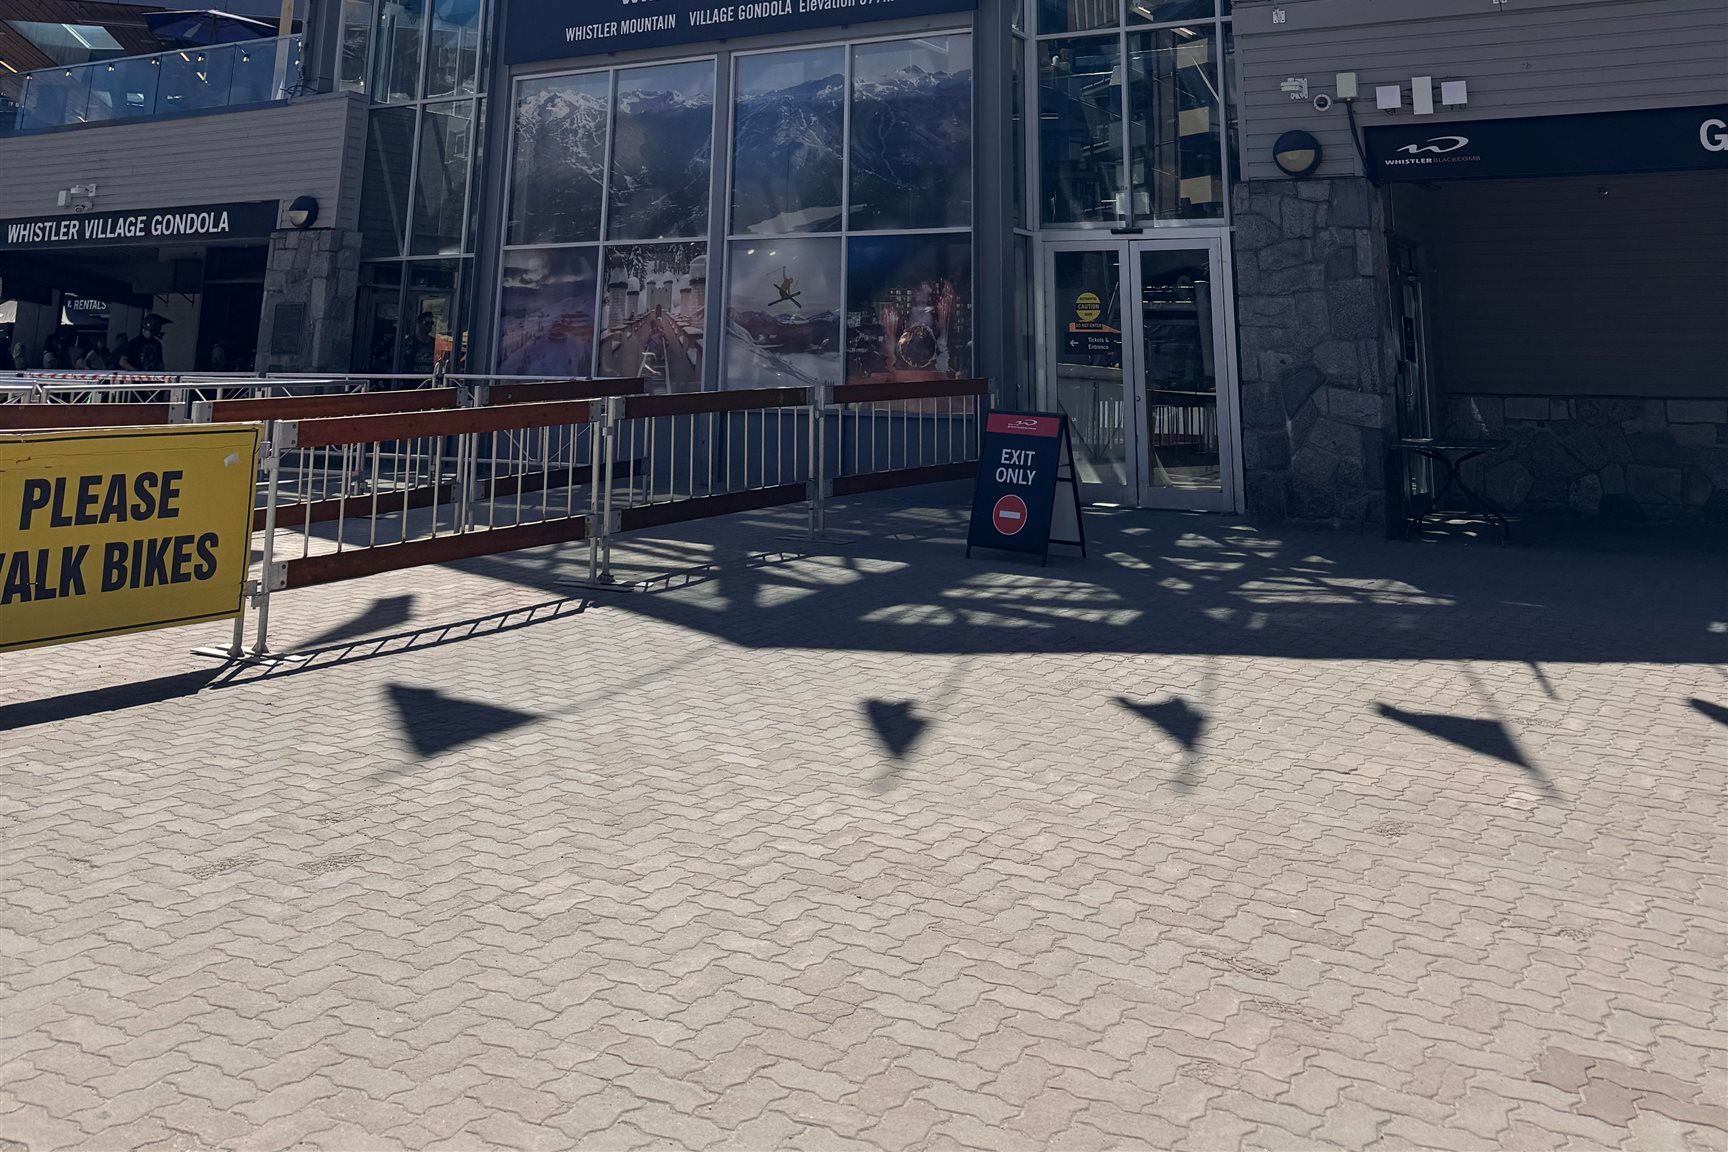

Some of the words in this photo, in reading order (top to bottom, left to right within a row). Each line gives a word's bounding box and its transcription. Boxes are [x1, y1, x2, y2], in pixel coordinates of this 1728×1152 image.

[565, 21, 617, 42] WHISTLER
[621, 14, 676, 35] MOUNTAIN
[689, 6, 734, 26] VILLAGE
[738, 0, 792, 20] GONDOLA
[1385, 157, 1432, 166] WHISTLER
[1433, 155, 1481, 164] BLACKCOMB
[7, 220, 79, 244] WHISTLER
[84, 216, 147, 240] VILLAGE
[151, 211, 230, 236] GONDOLA
[74, 299, 107, 310] RENTALS
[1001, 448, 1036, 466] EXIT
[995, 467, 1037, 485] ONLY
[19, 470, 183, 531] PLEASE
[0, 545, 90, 605] ALK
[101, 532, 219, 593] BIKES
